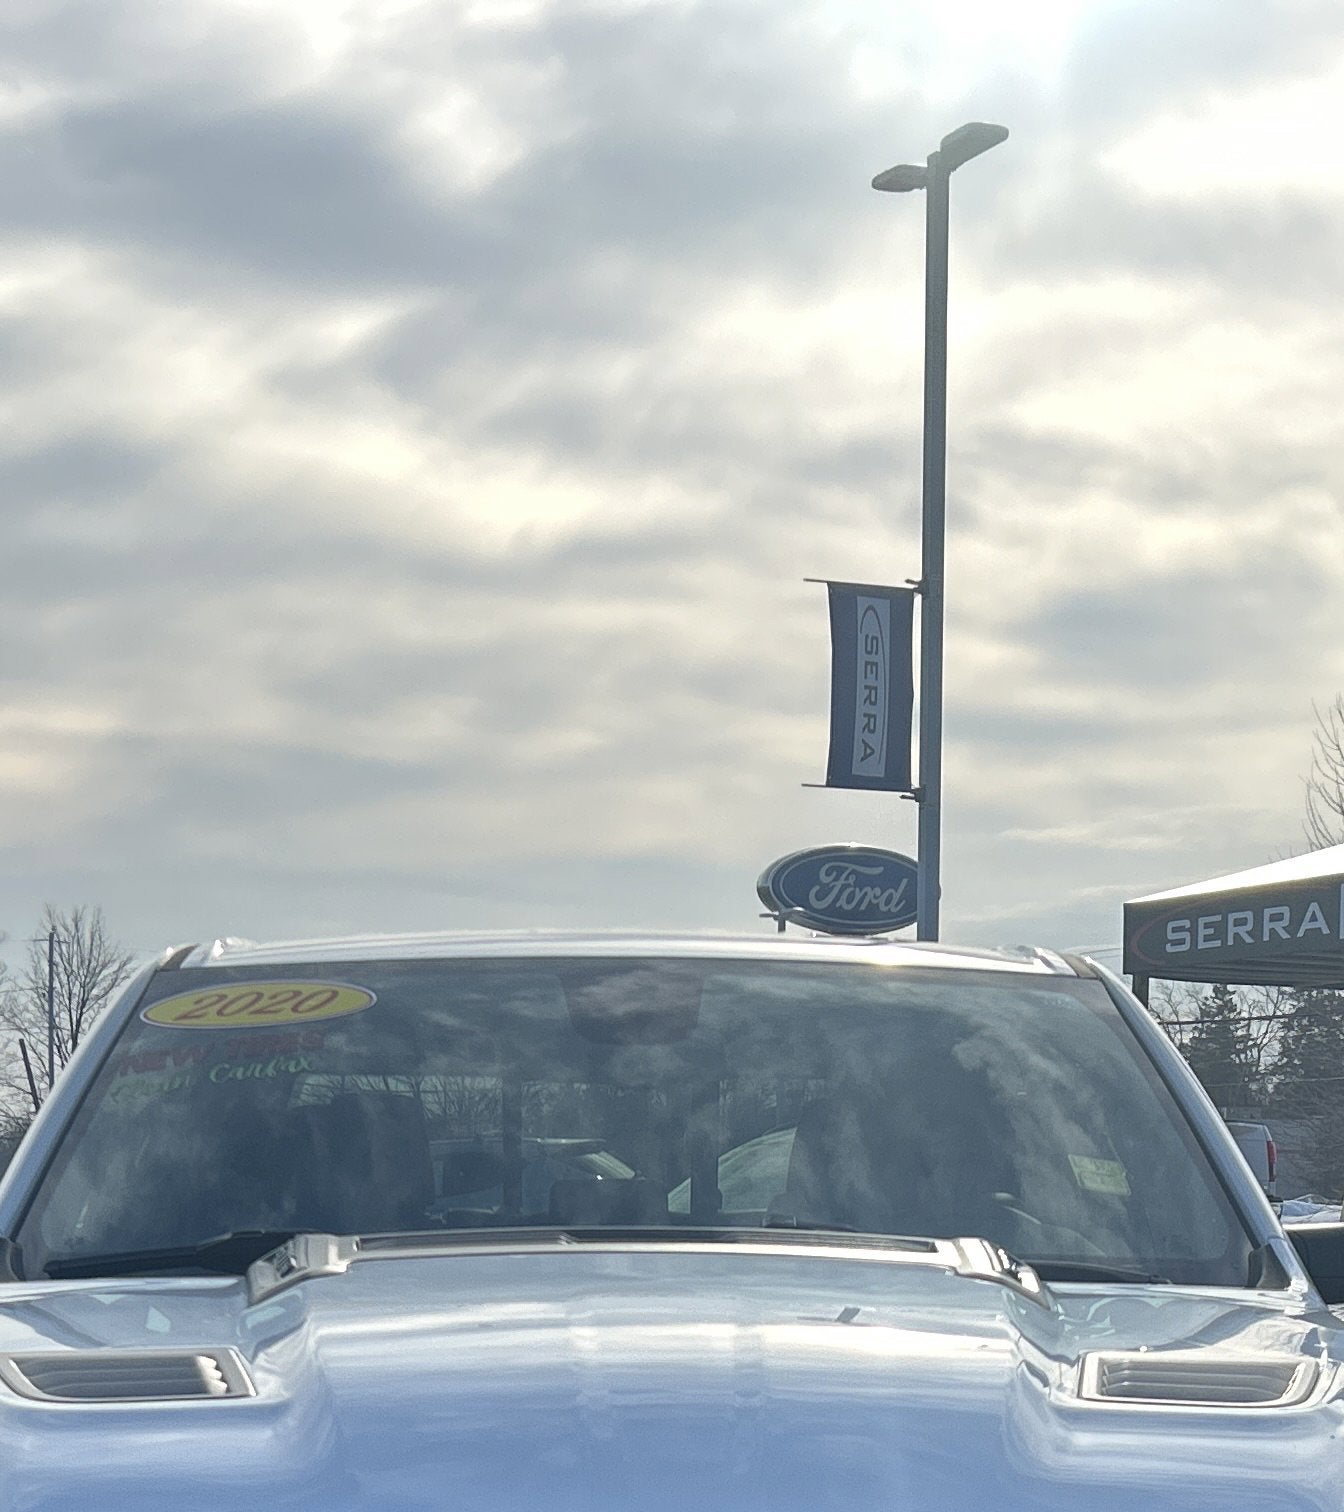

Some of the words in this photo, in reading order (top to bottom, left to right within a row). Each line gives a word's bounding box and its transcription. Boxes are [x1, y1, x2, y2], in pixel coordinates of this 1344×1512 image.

[858, 634, 880, 763] SERRA
[808, 861, 906, 913] Ford
[1165, 902, 1331, 953] SERRA
[173, 988, 340, 1022] 2020
